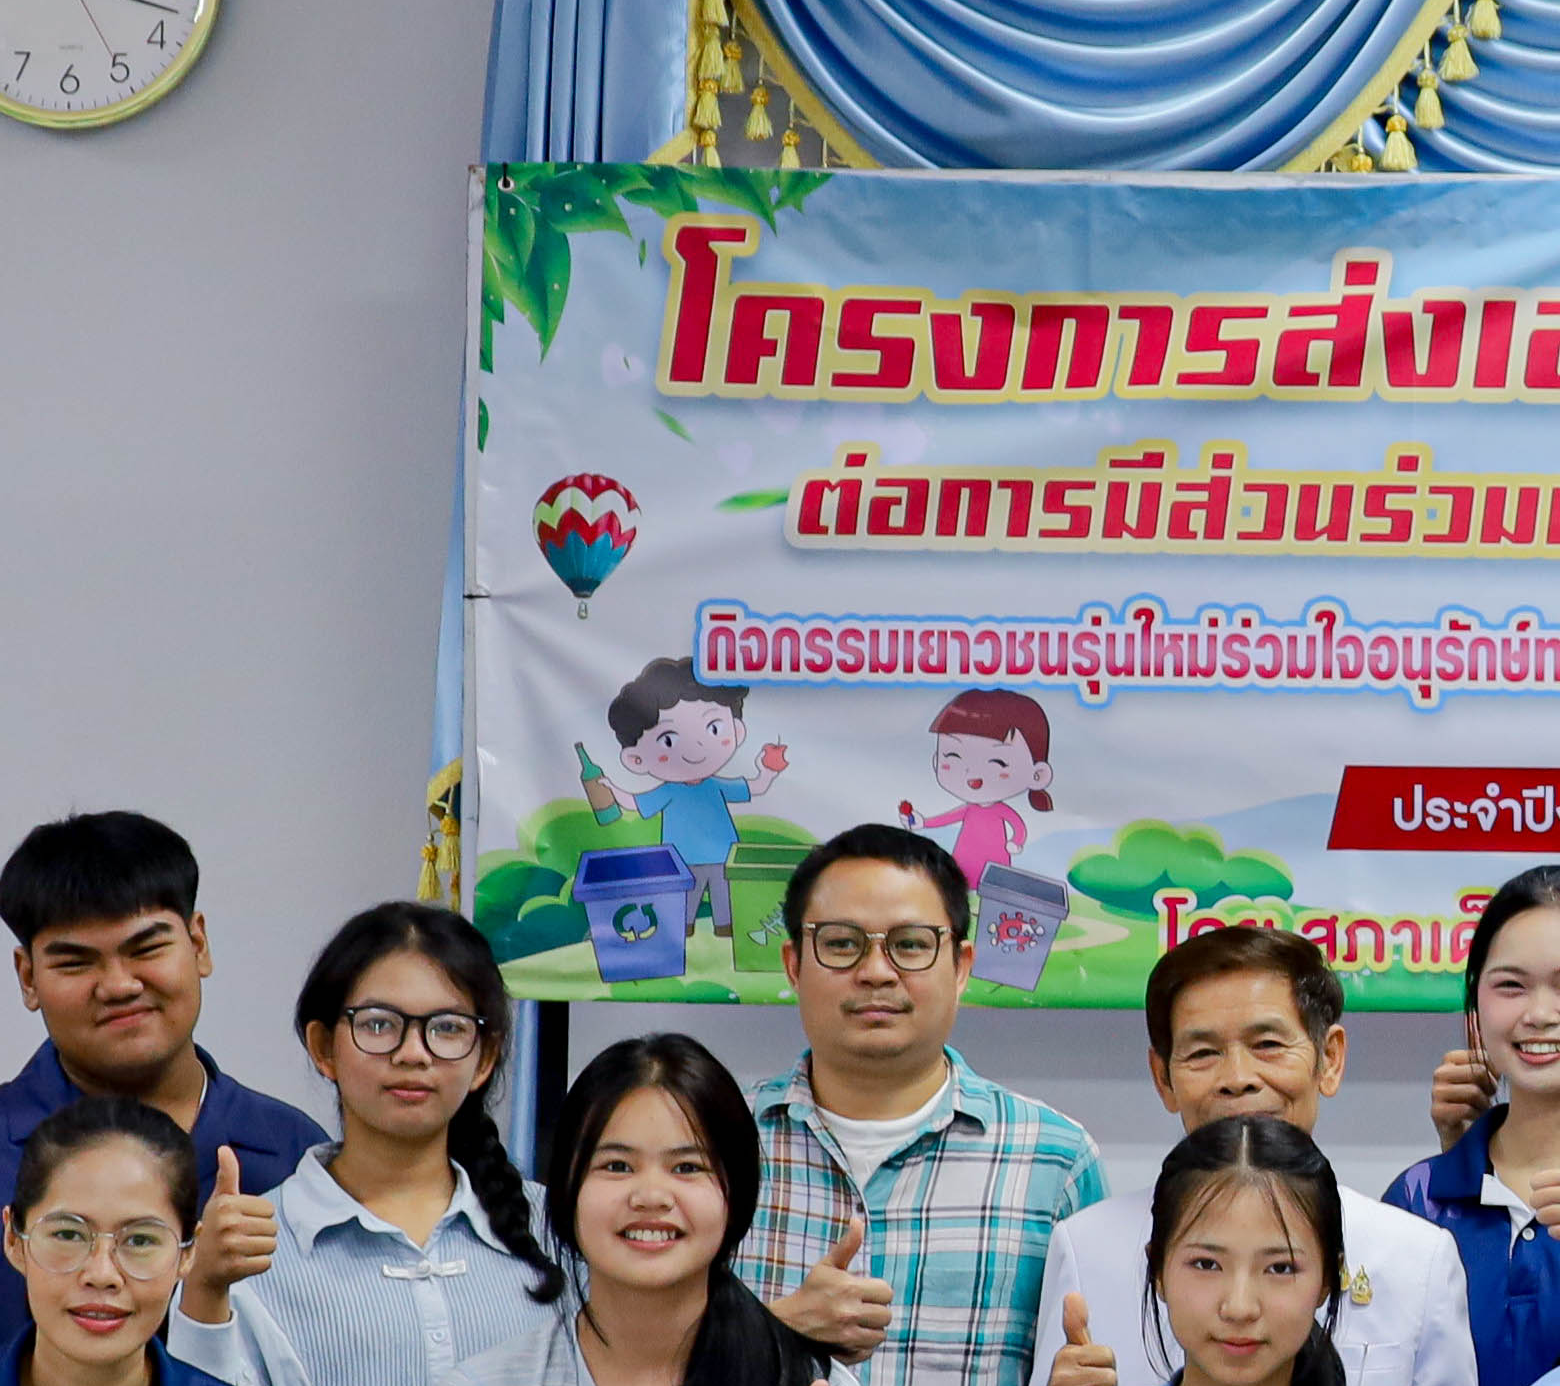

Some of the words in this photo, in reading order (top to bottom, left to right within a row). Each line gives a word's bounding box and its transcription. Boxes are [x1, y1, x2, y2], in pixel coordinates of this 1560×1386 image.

[146, 19, 166, 50] 4
[13, 51, 31, 82] 7
[59, 63, 80, 95] 6
[109, 52, 130, 84] 5
